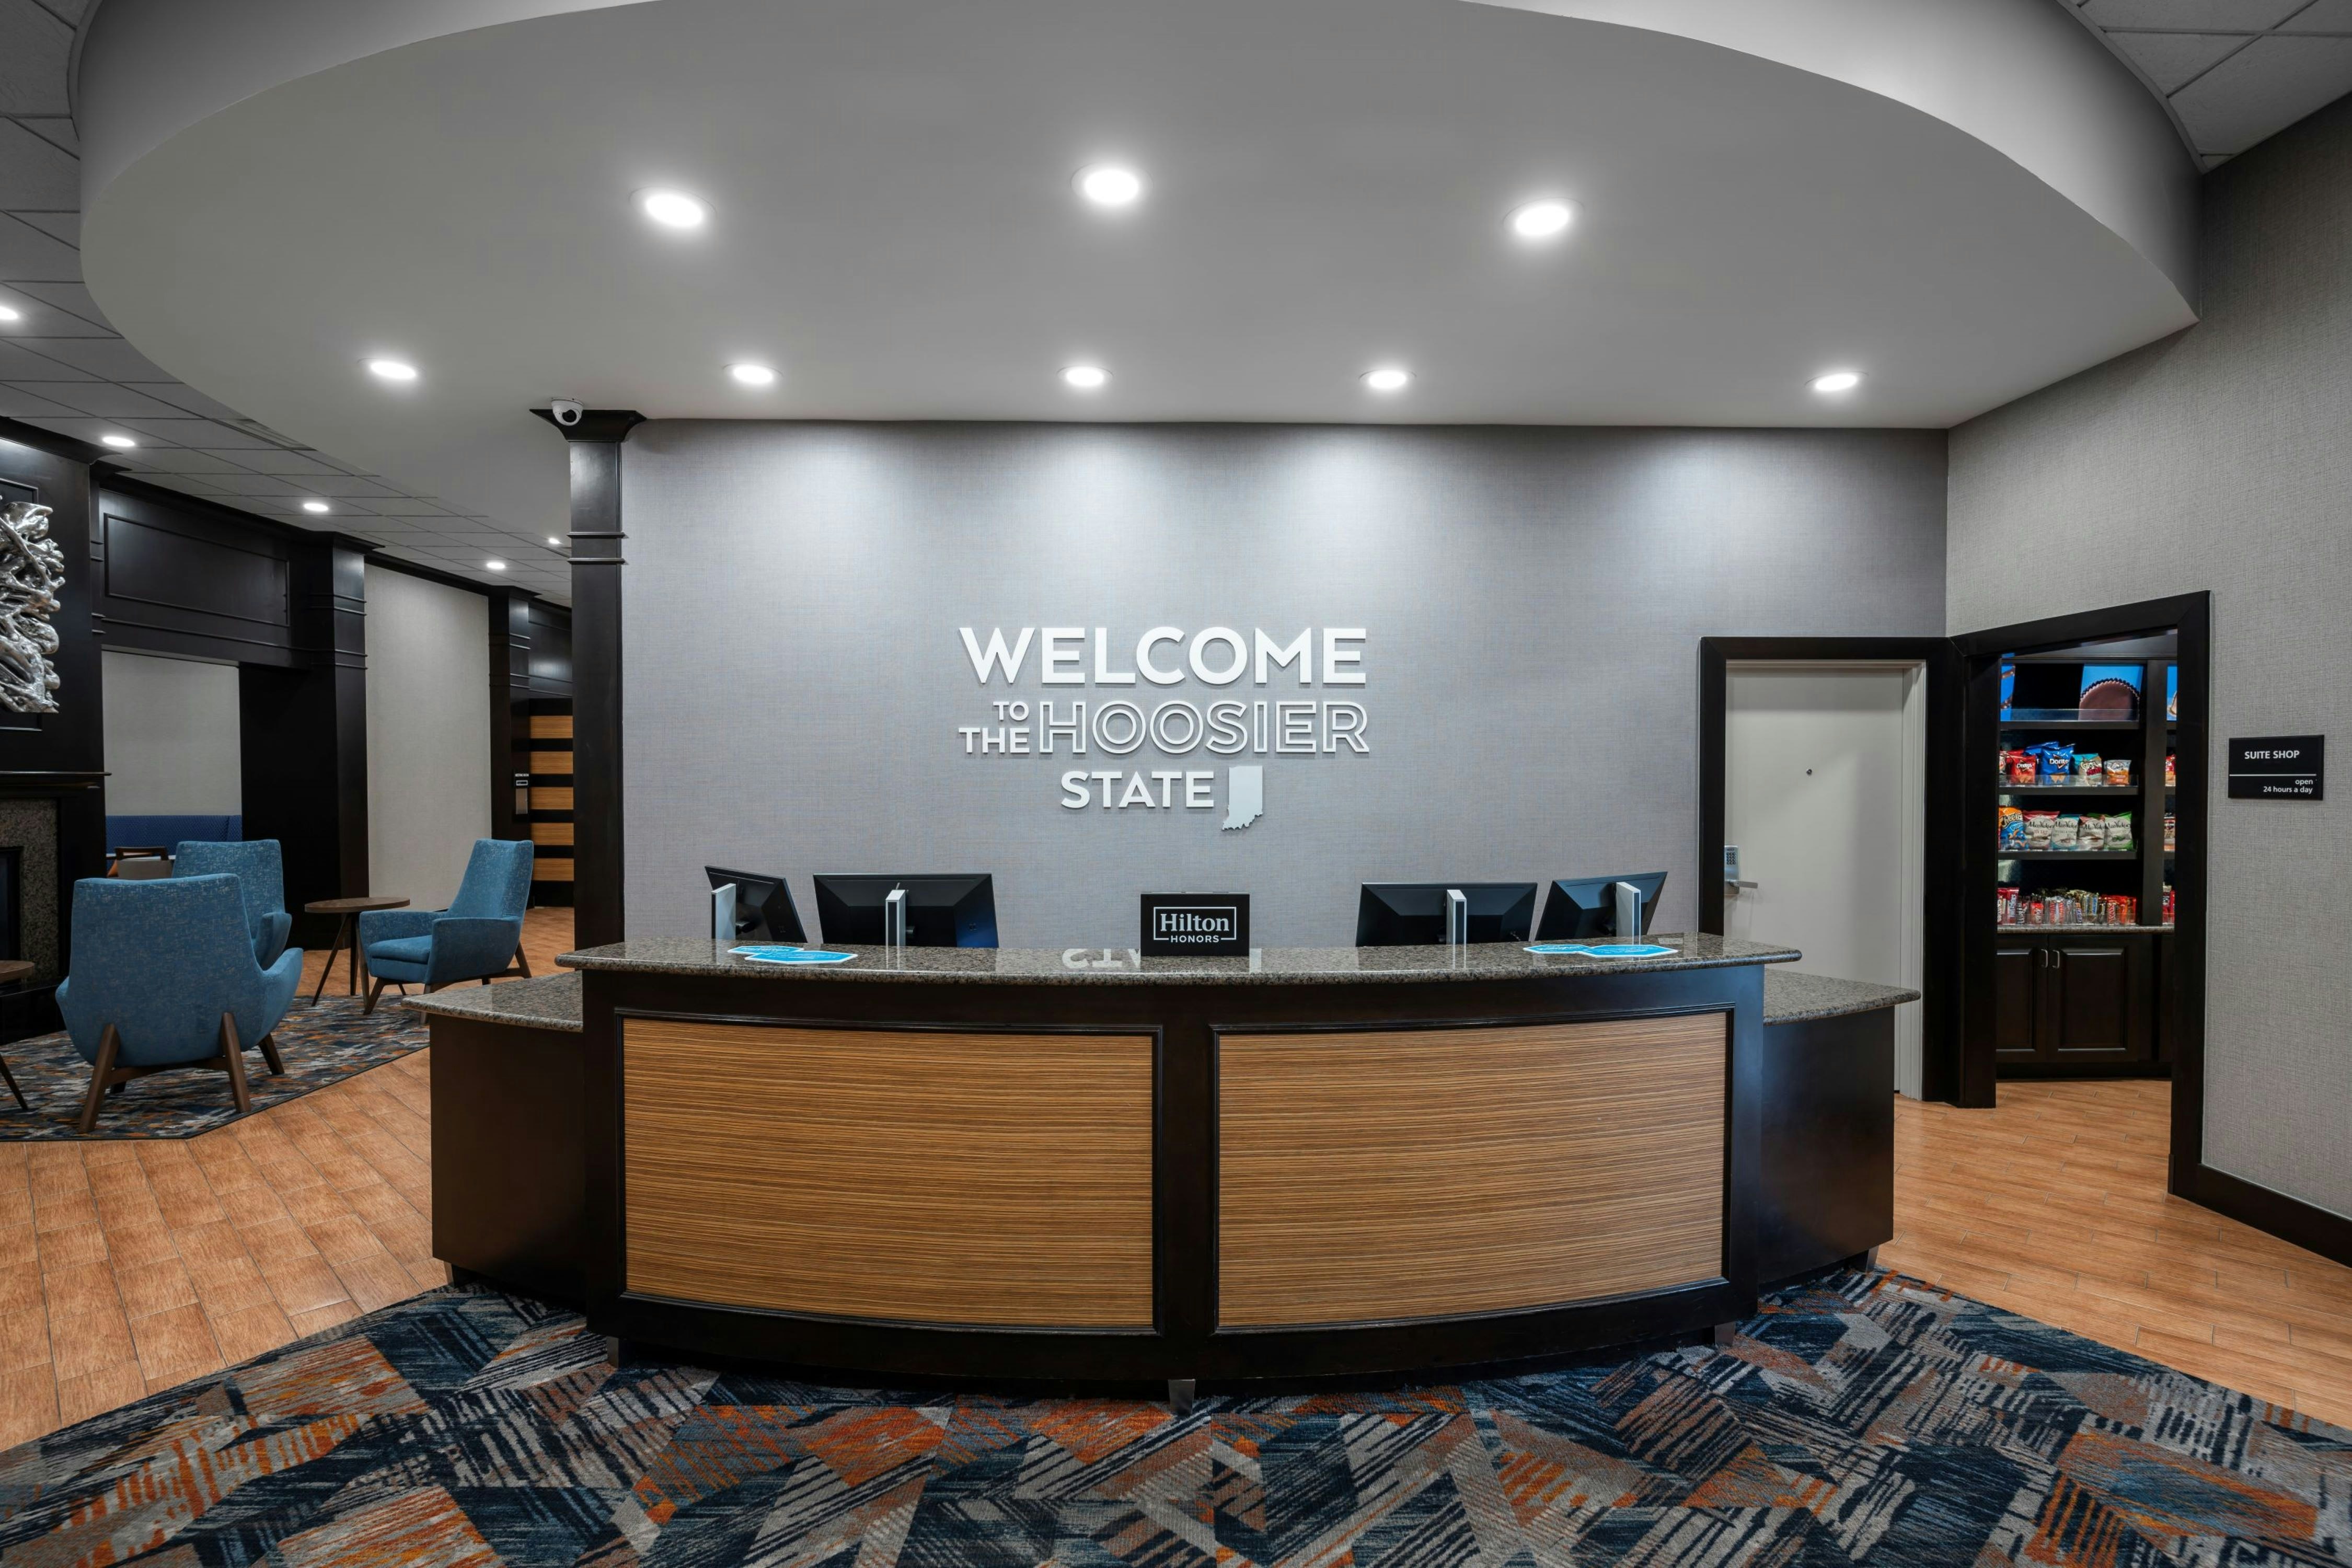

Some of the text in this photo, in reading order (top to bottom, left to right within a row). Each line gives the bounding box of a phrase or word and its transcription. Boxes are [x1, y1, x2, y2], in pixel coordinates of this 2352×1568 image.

[959, 626, 1366, 685] WELCOME
[993, 701, 1029, 721] TO
[958, 700, 1369, 754] THE HOOSIER
[2244, 750, 2300, 759] SUITE SHOP
[1061, 771, 1214, 808] STATE
[2300, 786, 2313, 794] day
[1160, 913, 1230, 932] Hilton
[1170, 935, 1219, 943] HONORS
